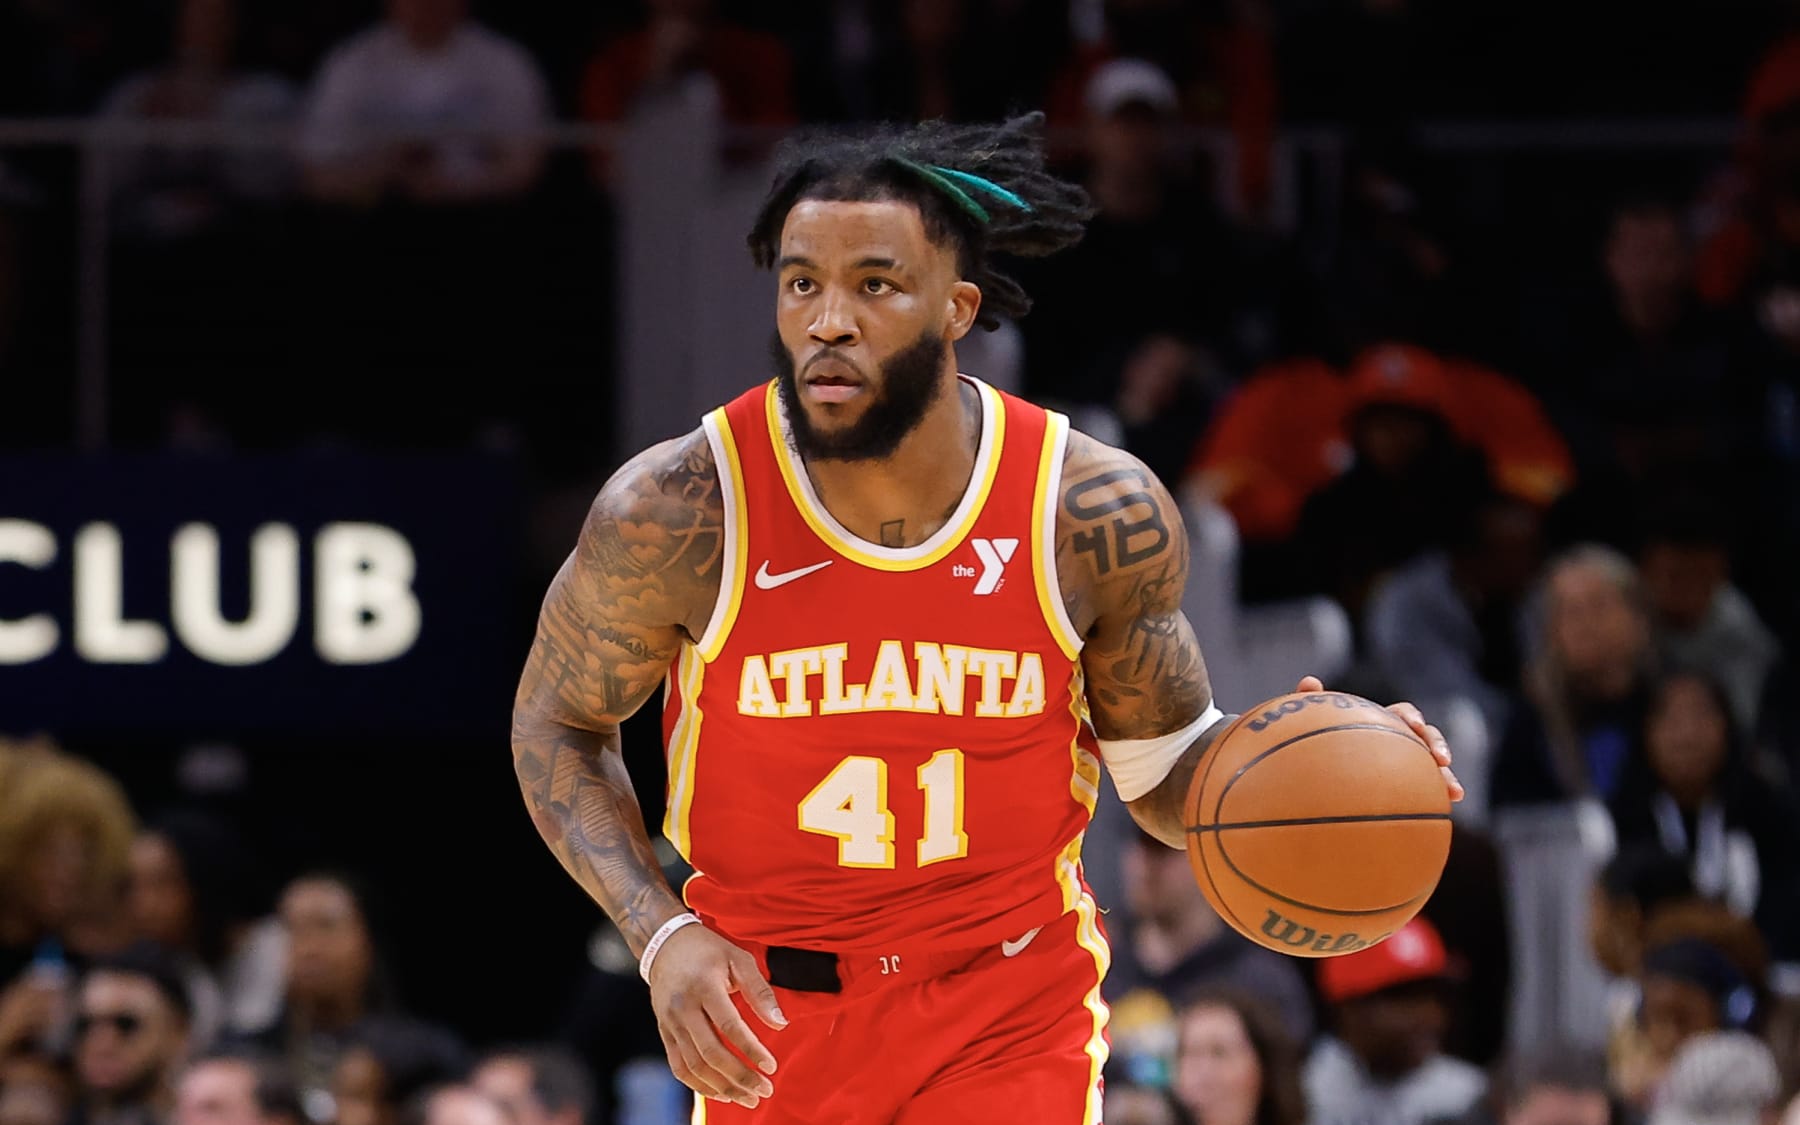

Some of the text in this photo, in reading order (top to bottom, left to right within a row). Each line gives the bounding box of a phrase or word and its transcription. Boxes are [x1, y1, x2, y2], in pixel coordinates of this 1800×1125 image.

[952, 563, 976, 578] the
[970, 537, 1020, 595] Y
[737, 640, 1046, 718] ATLANTA
[797, 748, 968, 869] 41
[1260, 907, 1393, 952] Wils
